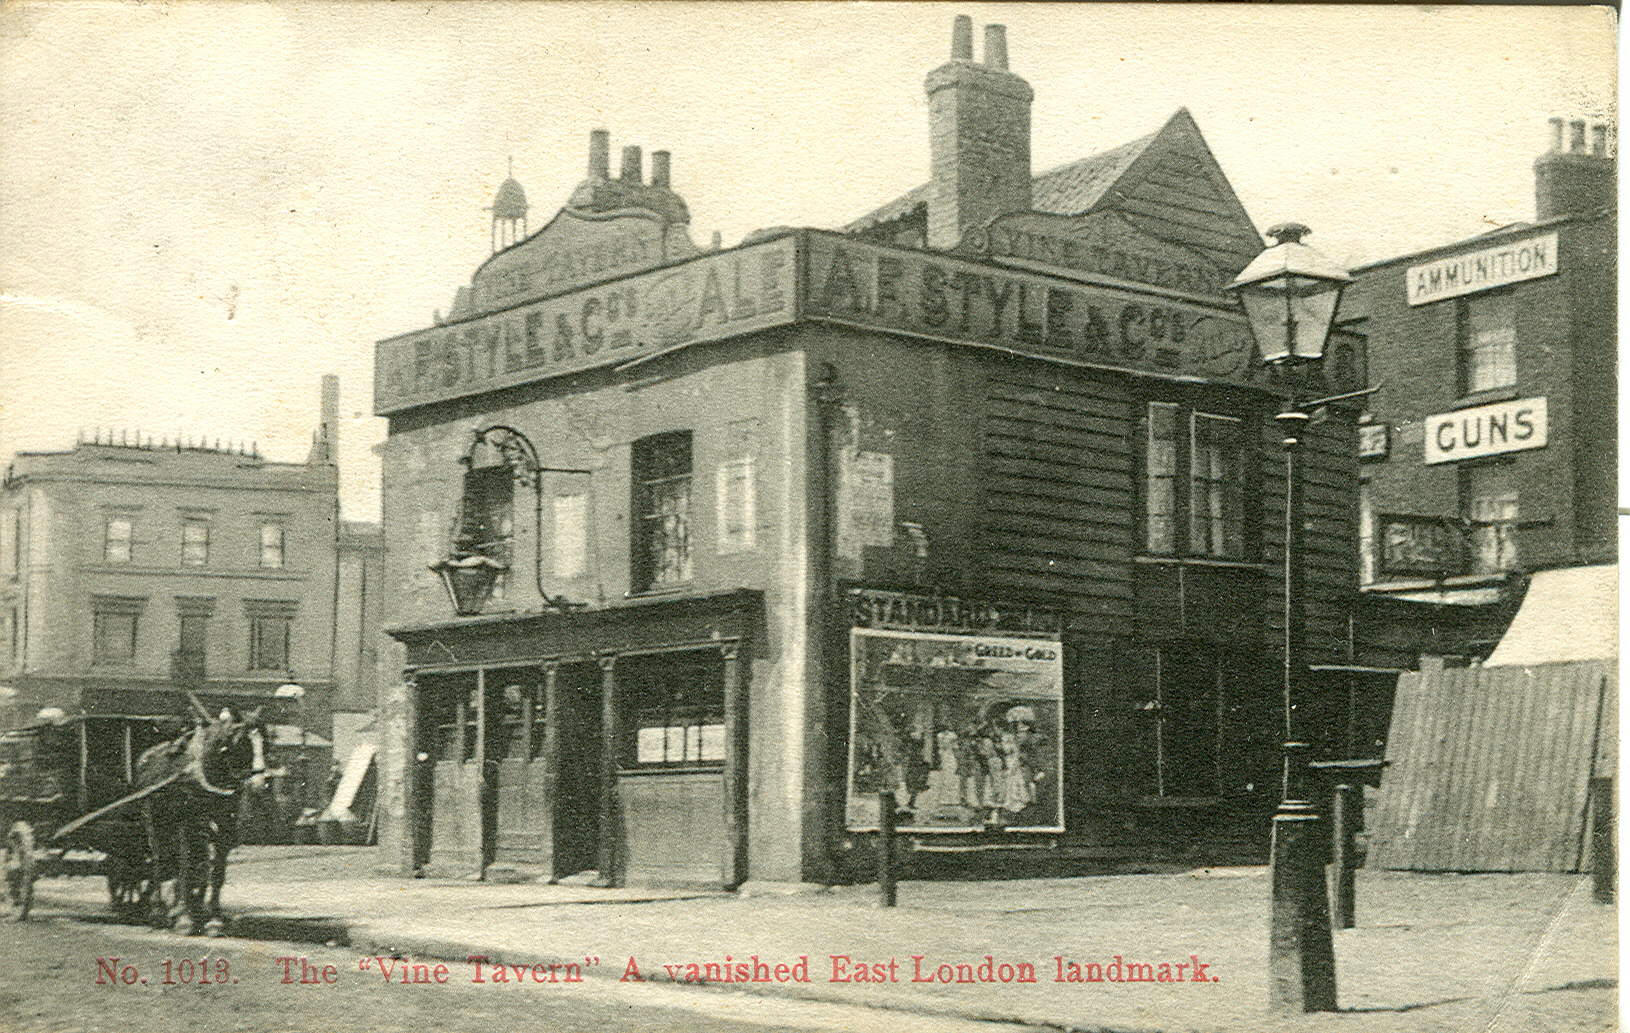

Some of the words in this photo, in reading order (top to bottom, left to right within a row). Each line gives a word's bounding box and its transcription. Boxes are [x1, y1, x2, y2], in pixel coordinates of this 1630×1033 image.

[693, 248, 785, 329] ALE
[1415, 242, 1546, 297] AMMUNITION
[922, 263, 1074, 349] STYLE
[1085, 304, 1108, 353] &
[1437, 409, 1534, 452] GUNS
